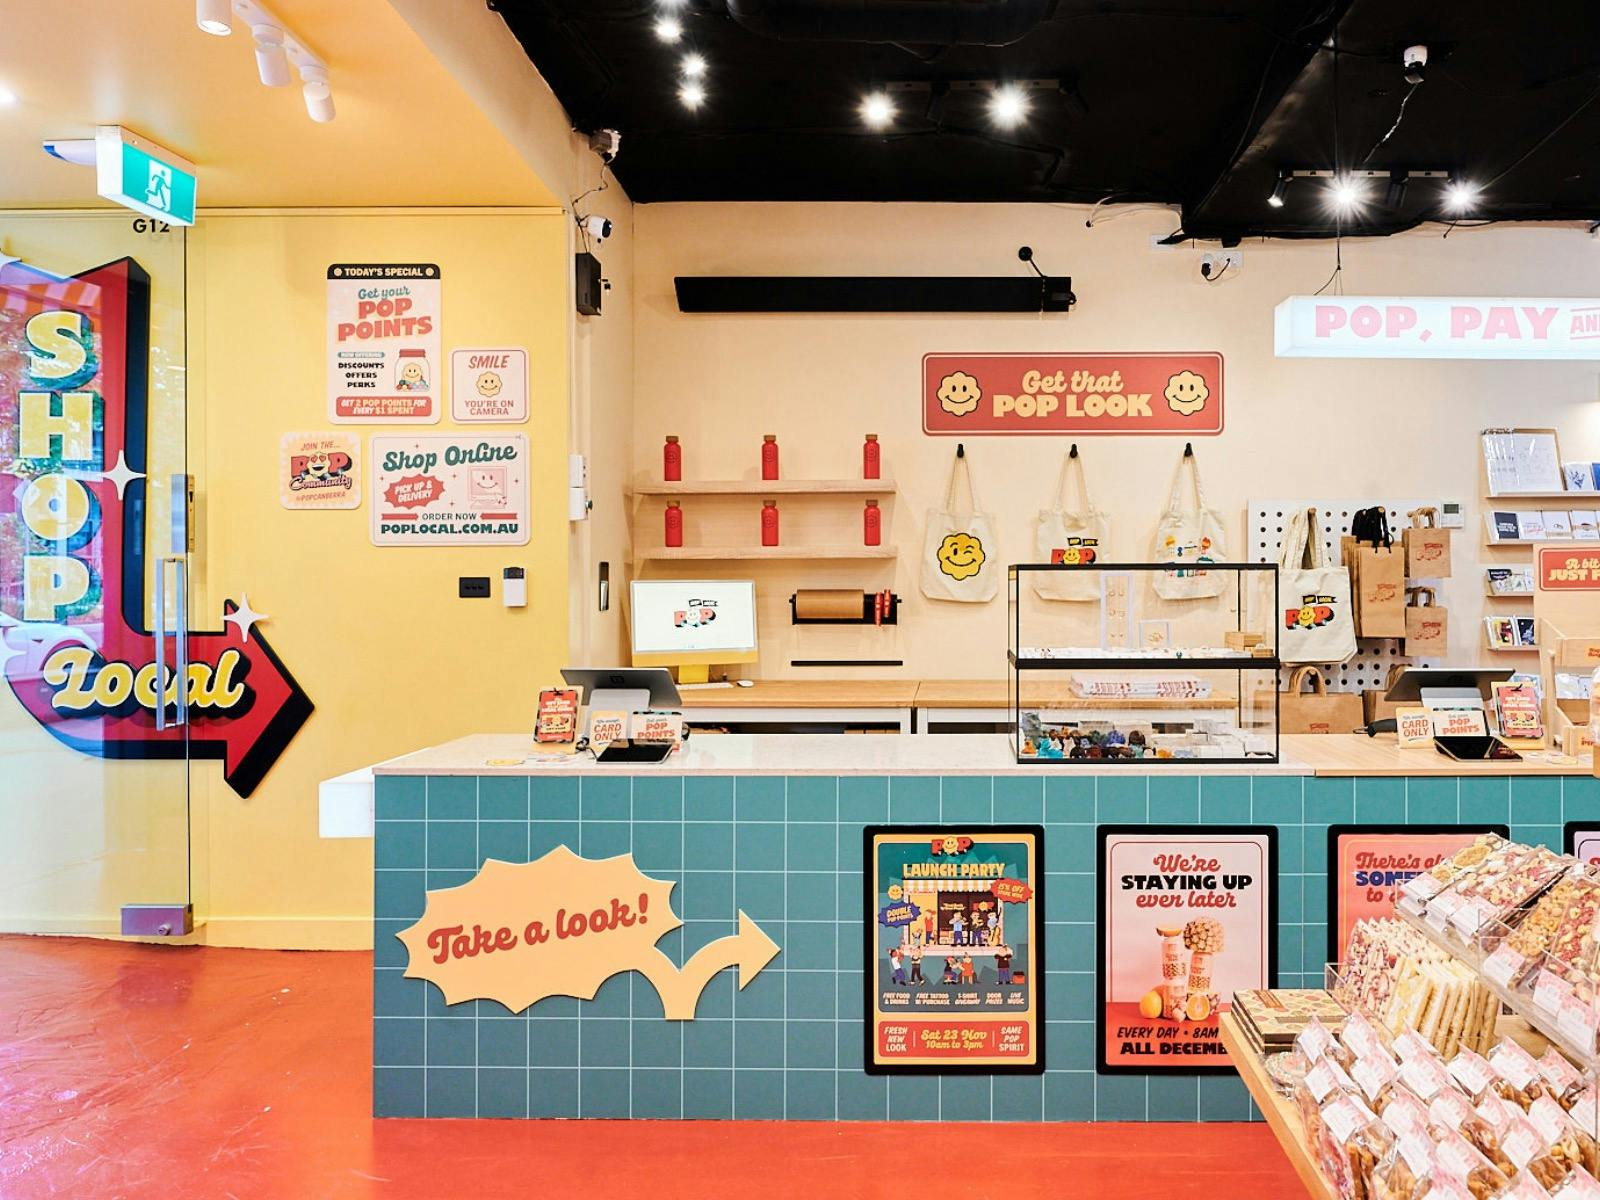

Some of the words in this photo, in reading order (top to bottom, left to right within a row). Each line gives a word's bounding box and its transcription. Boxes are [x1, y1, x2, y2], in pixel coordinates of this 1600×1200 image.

[132, 218, 170, 233] G12
[344, 267, 383, 277] TODAY'S
[384, 267, 424, 277] SPECIAL
[358, 288, 379, 300] Get
[381, 286, 411, 301] your
[358, 298, 412, 319] POP
[338, 316, 433, 342] POINTS
[1315, 304, 1432, 343] POP,
[1450, 306, 1560, 340] PAY
[1570, 314, 1600, 334] AN
[468, 355, 510, 369] SMILE
[1021, 370, 1068, 393] Get
[1071, 370, 1124, 393] that
[464, 400, 499, 408] YOU'RE
[993, 394, 1059, 417] POP
[1066, 394, 1153, 417] LOOK
[301, 442, 317, 451] JOIN
[382, 450, 437, 473] Shop
[445, 442, 518, 466] Online
[18, 310, 98, 622] SHOP
[289, 475, 353, 491] Community
[380, 523, 519, 534] POPLOCAL.COM.AU
[1549, 569, 1588, 581] JUST
[43, 646, 246, 709] Local
[594, 723, 622, 733] CARD
[646, 722, 668, 731] POP
[1402, 719, 1429, 729] CARD
[1449, 718, 1470, 727] POP
[594, 731, 622, 741] ONLY
[637, 729, 676, 739] POINTS
[1403, 727, 1430, 737] ONLY
[1442, 725, 1480, 735] POINTS
[1152, 854, 1221, 873] We're
[1355, 852, 1420, 869] There's
[902, 863, 958, 879] LAUNCH
[960, 863, 1006, 878] PARTY
[1121, 875, 1217, 890] STAYING
[1222, 875, 1253, 890] UP
[1135, 893, 1184, 908] ever
[1188, 891, 1237, 908] later
[1366, 887, 1384, 902] to
[427, 924, 518, 965] Take
[524, 921, 550, 946] a
[555, 893, 649, 940] look!
[884, 1026, 908, 1035] FRESH
[921, 1029, 942, 1041] Sat
[943, 1029, 959, 1041] 23
[961, 1028, 988, 1041] Nov
[1001, 1026, 1023, 1035] SAME
[1117, 1026, 1154, 1039] EVERY
[1156, 1026, 1180, 1039] DAY
[1192, 1027, 1219, 1039] 8AM
[887, 1035, 906, 1043] NEW
[926, 1040, 951, 1049] 10am
[951, 1040, 961, 1049] to
[963, 1040, 984, 1051] 3pm
[1003, 1035, 1021, 1043] POP
[885, 1043, 907, 1052] LOOK
[999, 1043, 1025, 1052] SPIRIT
[1120, 1042, 1155, 1055] ALL
